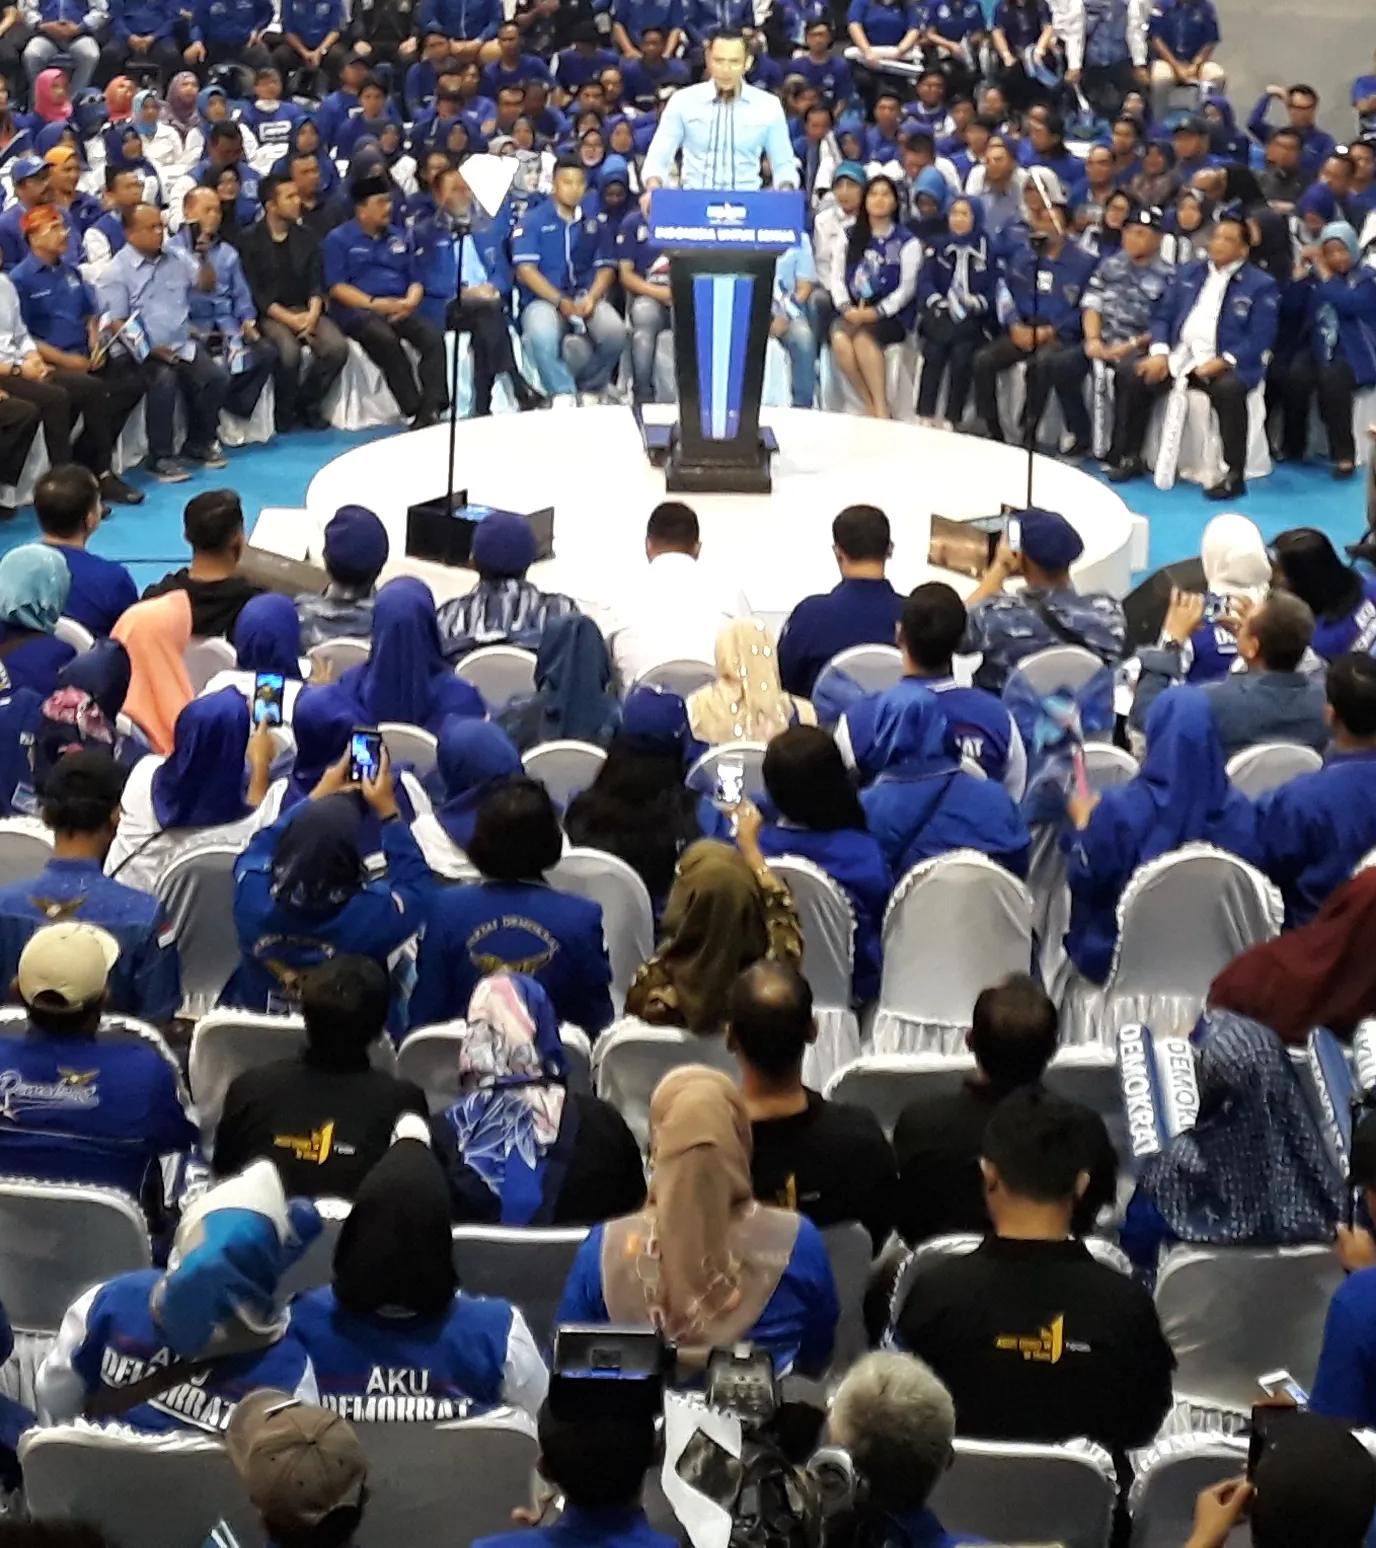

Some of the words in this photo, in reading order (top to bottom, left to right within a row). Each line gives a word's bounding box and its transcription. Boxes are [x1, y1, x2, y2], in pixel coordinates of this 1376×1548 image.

[1166, 1041, 1199, 1130] DEMOK
[367, 1365, 430, 1395] AKU
[321, 1393, 474, 1422] DEMOKRAT
